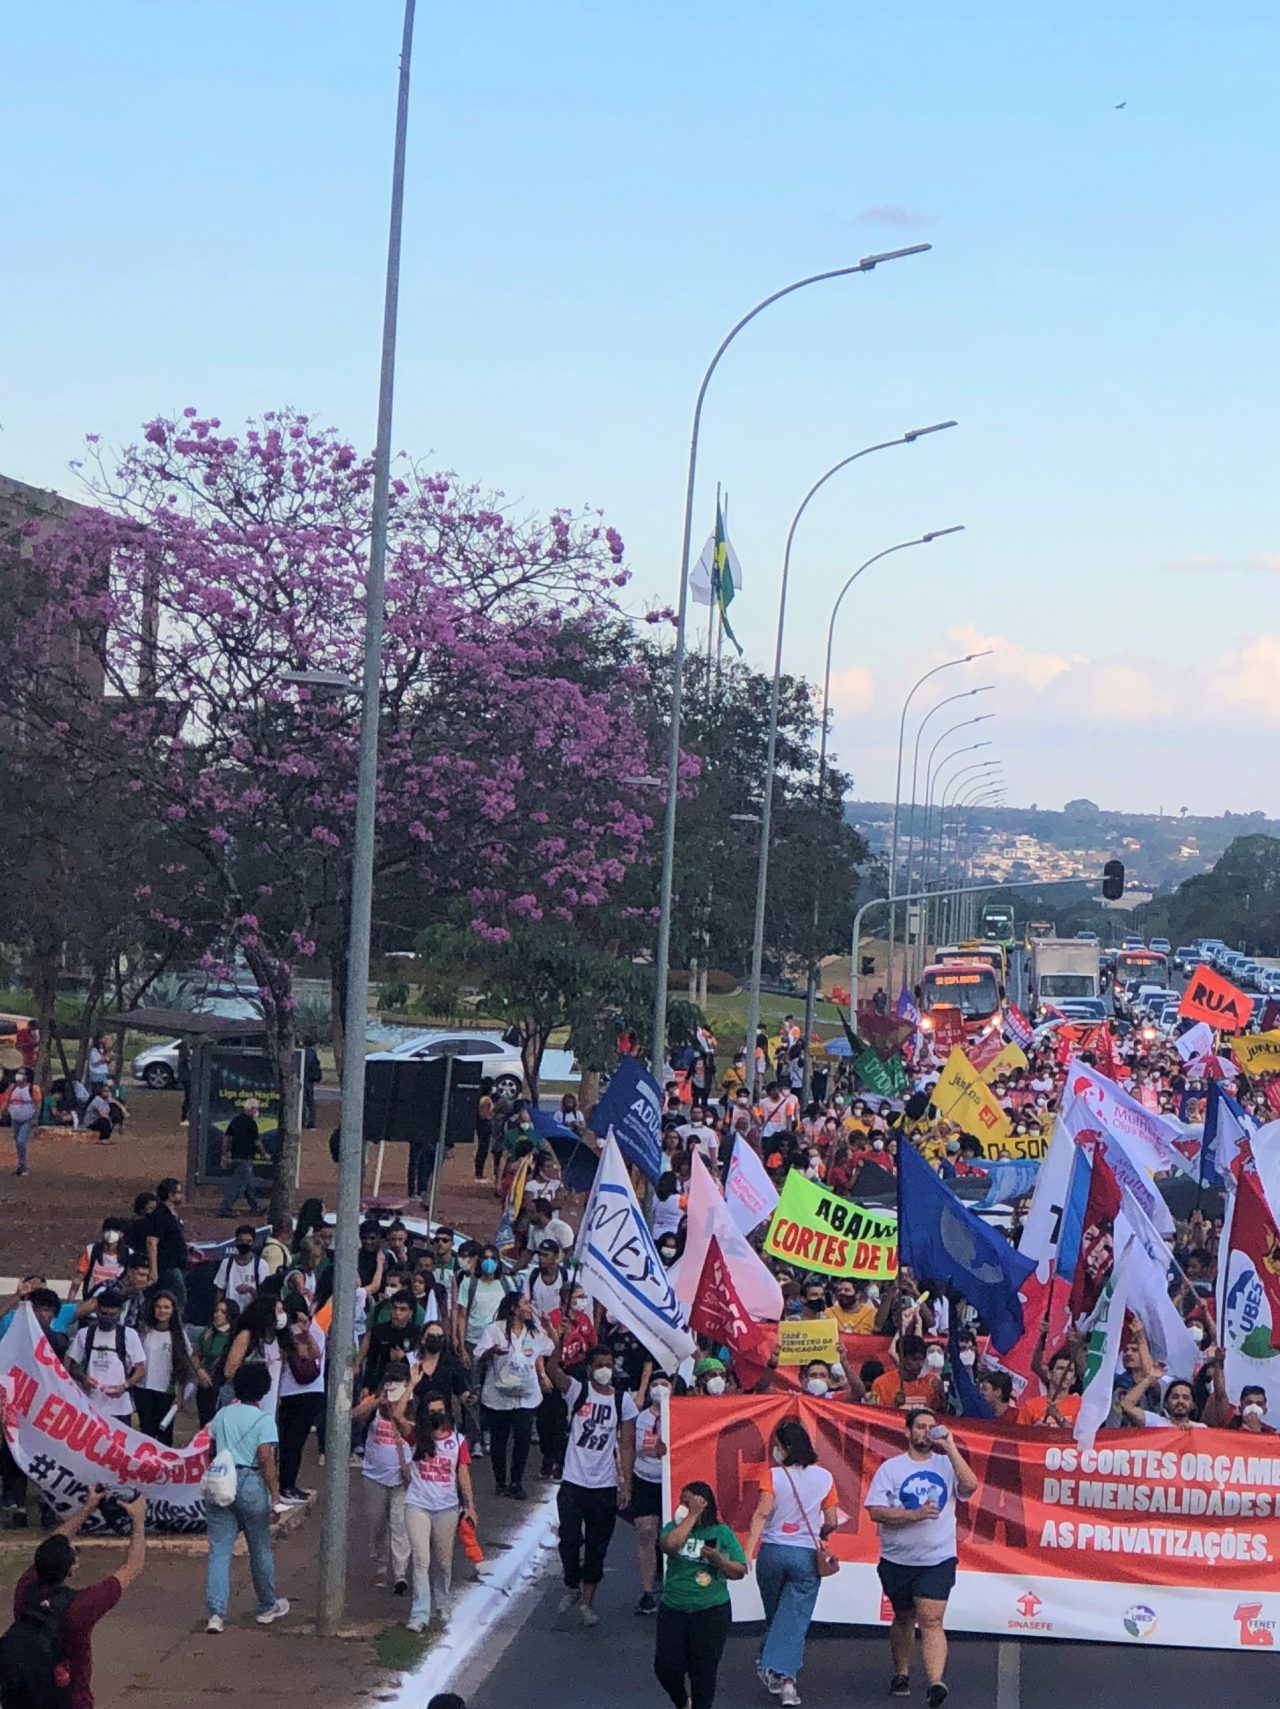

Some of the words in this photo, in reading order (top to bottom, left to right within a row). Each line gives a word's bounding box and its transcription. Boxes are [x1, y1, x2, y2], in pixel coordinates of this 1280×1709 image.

[1192, 982, 1239, 1018] RUA
[772, 1218, 849, 1269] CORTES
[852, 1242, 881, 1272] DE
[1239, 1281, 1264, 1334] UBES
[591, 1402, 612, 1425] UP
[1045, 1446, 1078, 1472] OS
[1080, 1448, 1178, 1480] CORTES
[1042, 1477, 1074, 1506] DE
[1077, 1480, 1273, 1517] MENSALIDADES
[1040, 1520, 1075, 1549] AS
[1077, 1522, 1274, 1565] PRIVATIZAÇÕES.
[1007, 1620, 1054, 1632] SINASEFE
[1131, 1613, 1153, 1624] UBES
[1249, 1619, 1277, 1630] FENET
